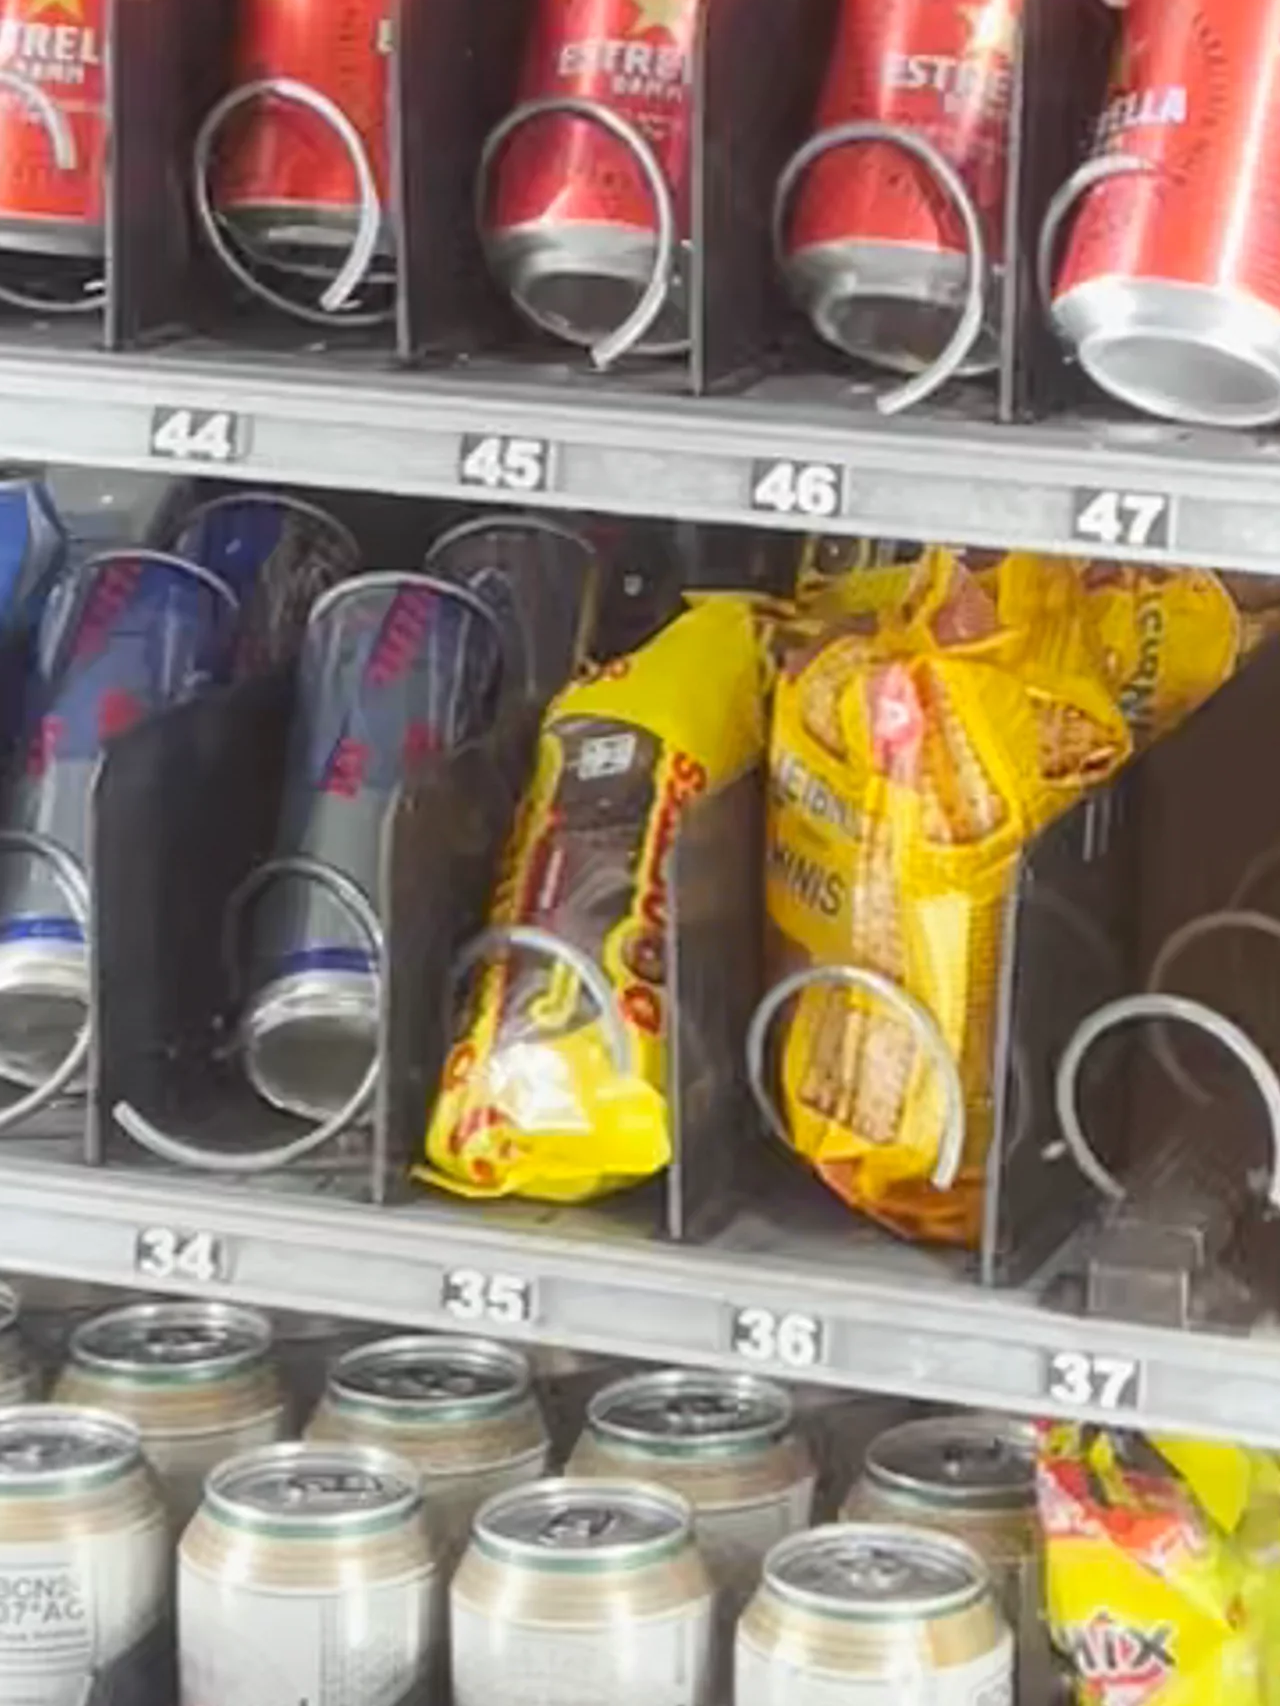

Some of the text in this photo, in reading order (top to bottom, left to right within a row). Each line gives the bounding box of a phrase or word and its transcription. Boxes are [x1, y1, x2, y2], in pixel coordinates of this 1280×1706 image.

[150, 410, 236, 460] 44
[461, 437, 544, 488] 45
[753, 464, 839, 514] 46
[1077, 491, 1164, 543] 47
[138, 1231, 220, 1280] 34
[443, 1271, 525, 1318] 35
[732, 1312, 817, 1365] 36
[1051, 1352, 1135, 1408] 37
